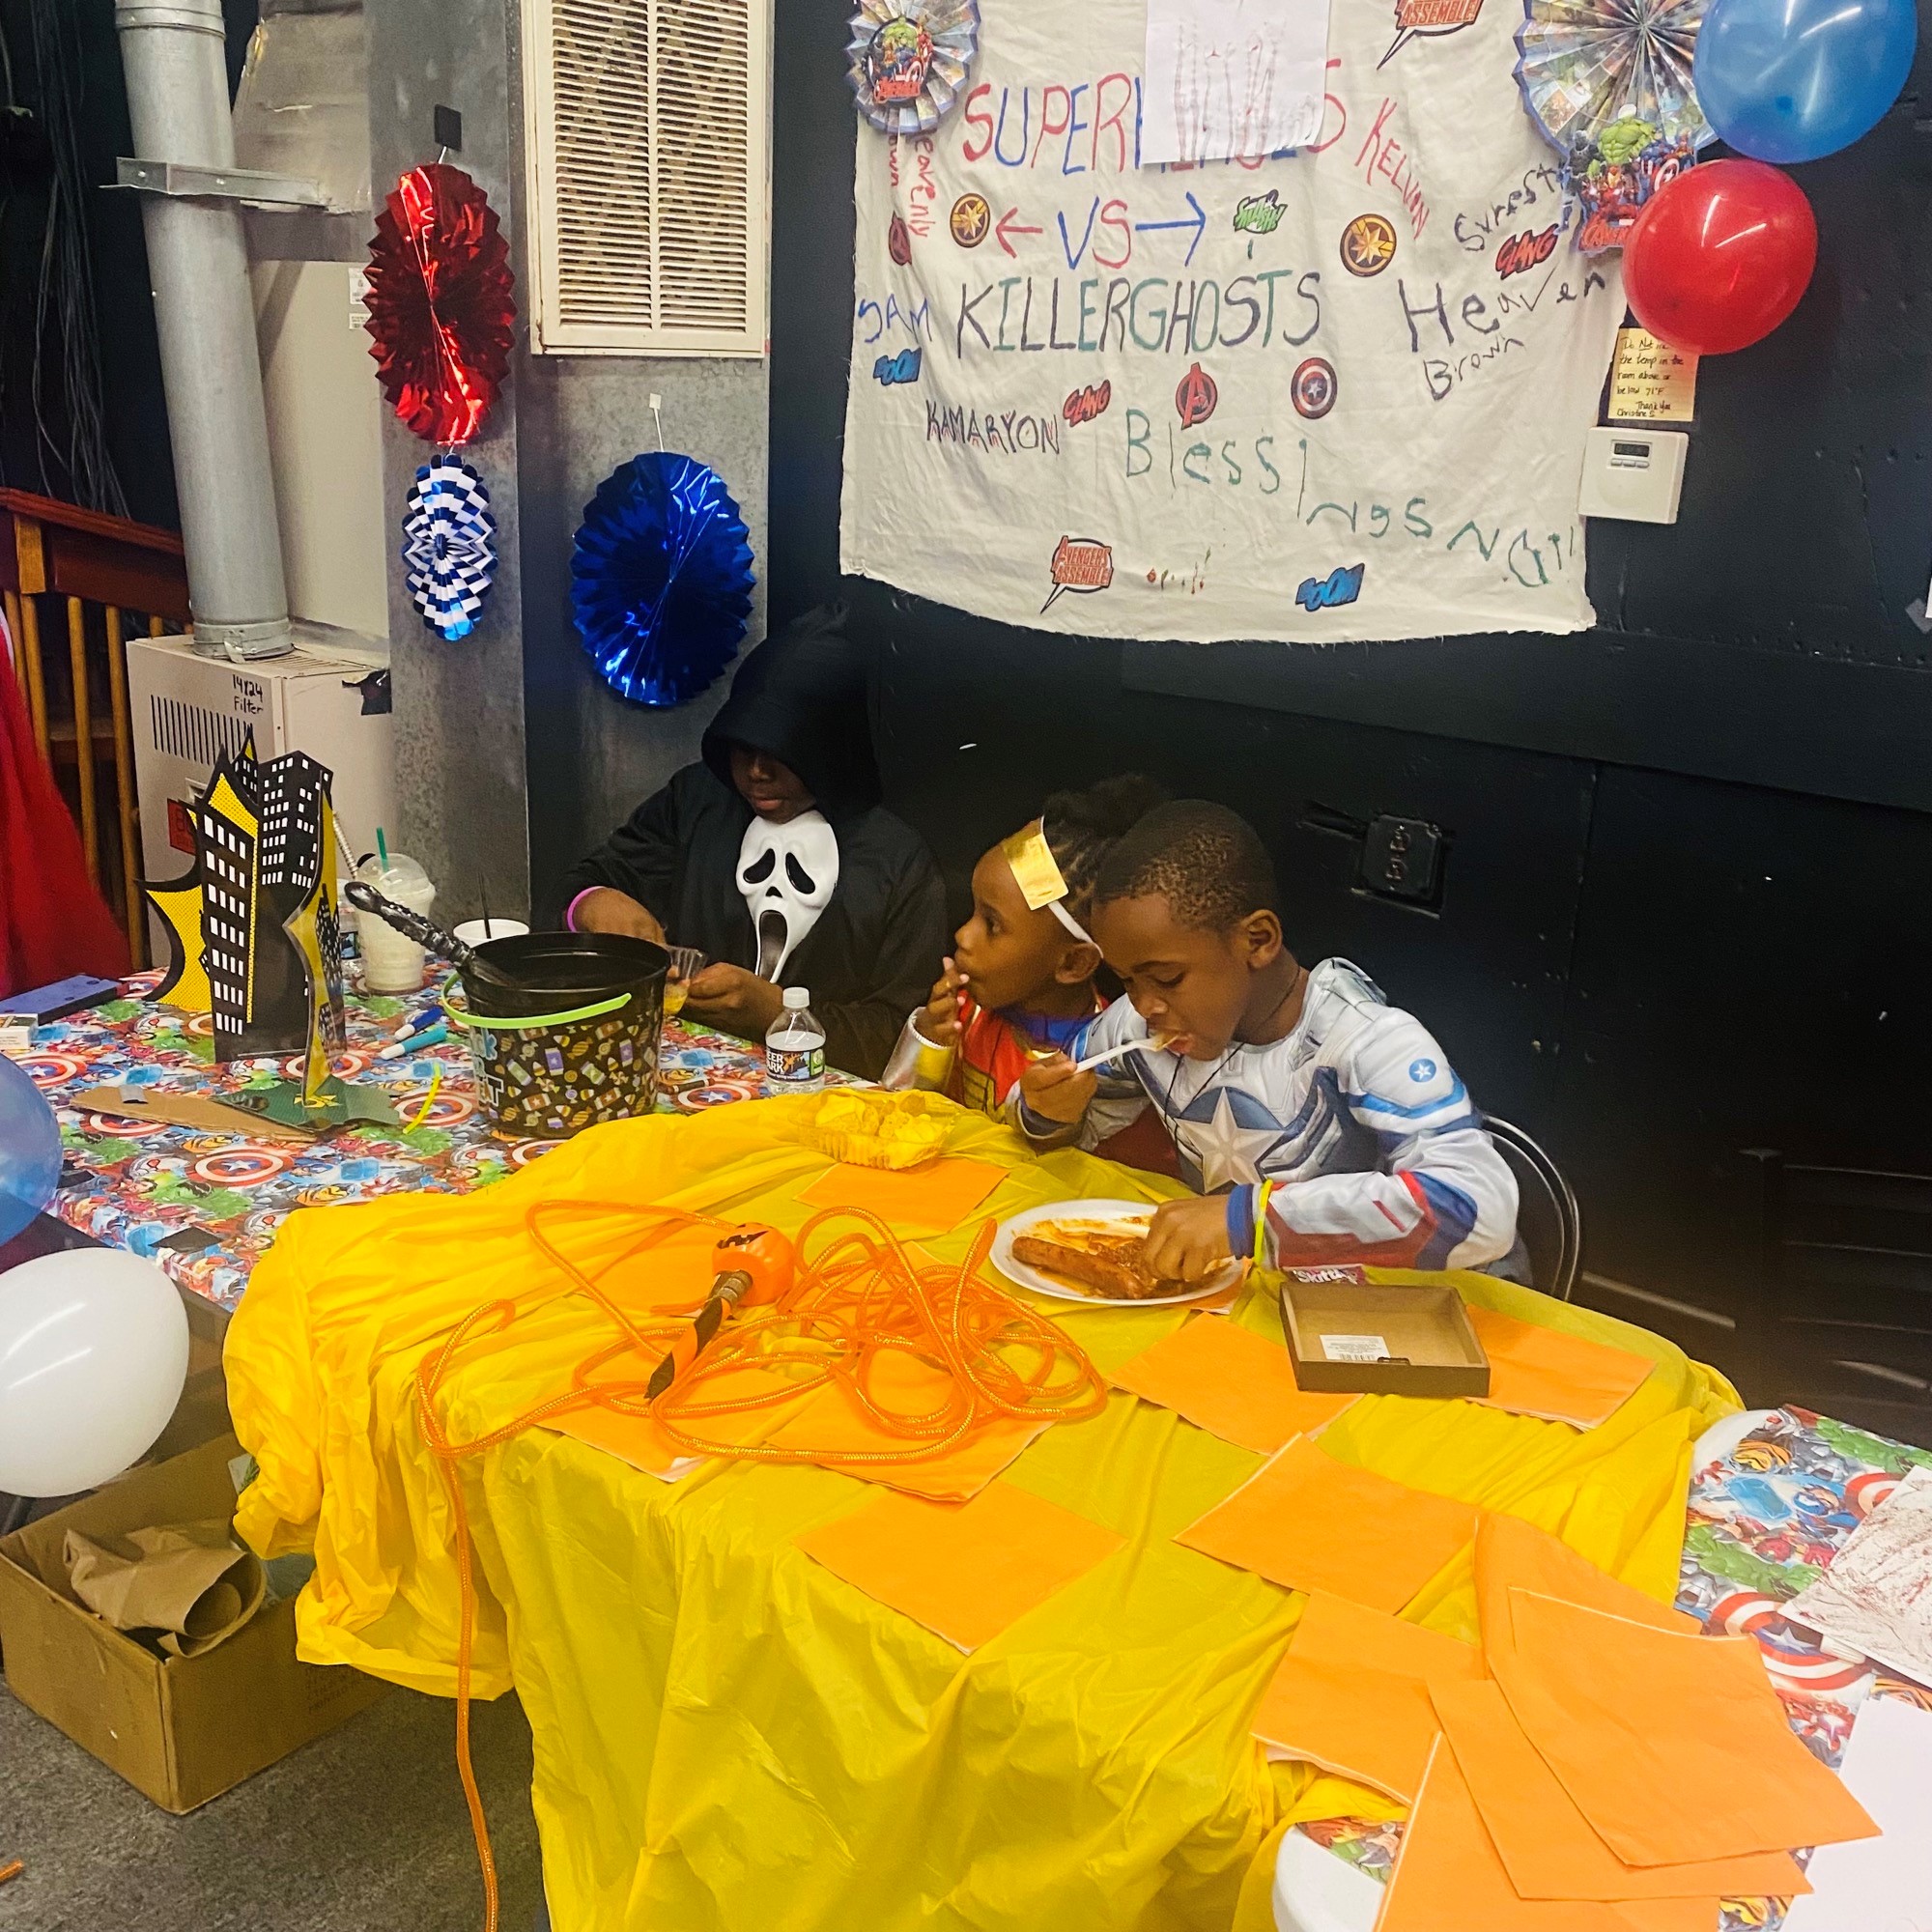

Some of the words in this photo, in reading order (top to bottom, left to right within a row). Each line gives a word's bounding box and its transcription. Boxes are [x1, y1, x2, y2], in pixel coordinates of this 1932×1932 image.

[1355, 97, 1430, 241] KELVIN
[1058, 196, 1131, 270] VS
[858, 293, 932, 343] SAM
[1424, 337, 1524, 401] Brown
[1636, 353, 1658, 369] temp
[924, 400, 1061, 455] KAMARYON
[234, 696, 264, 715] Filter
